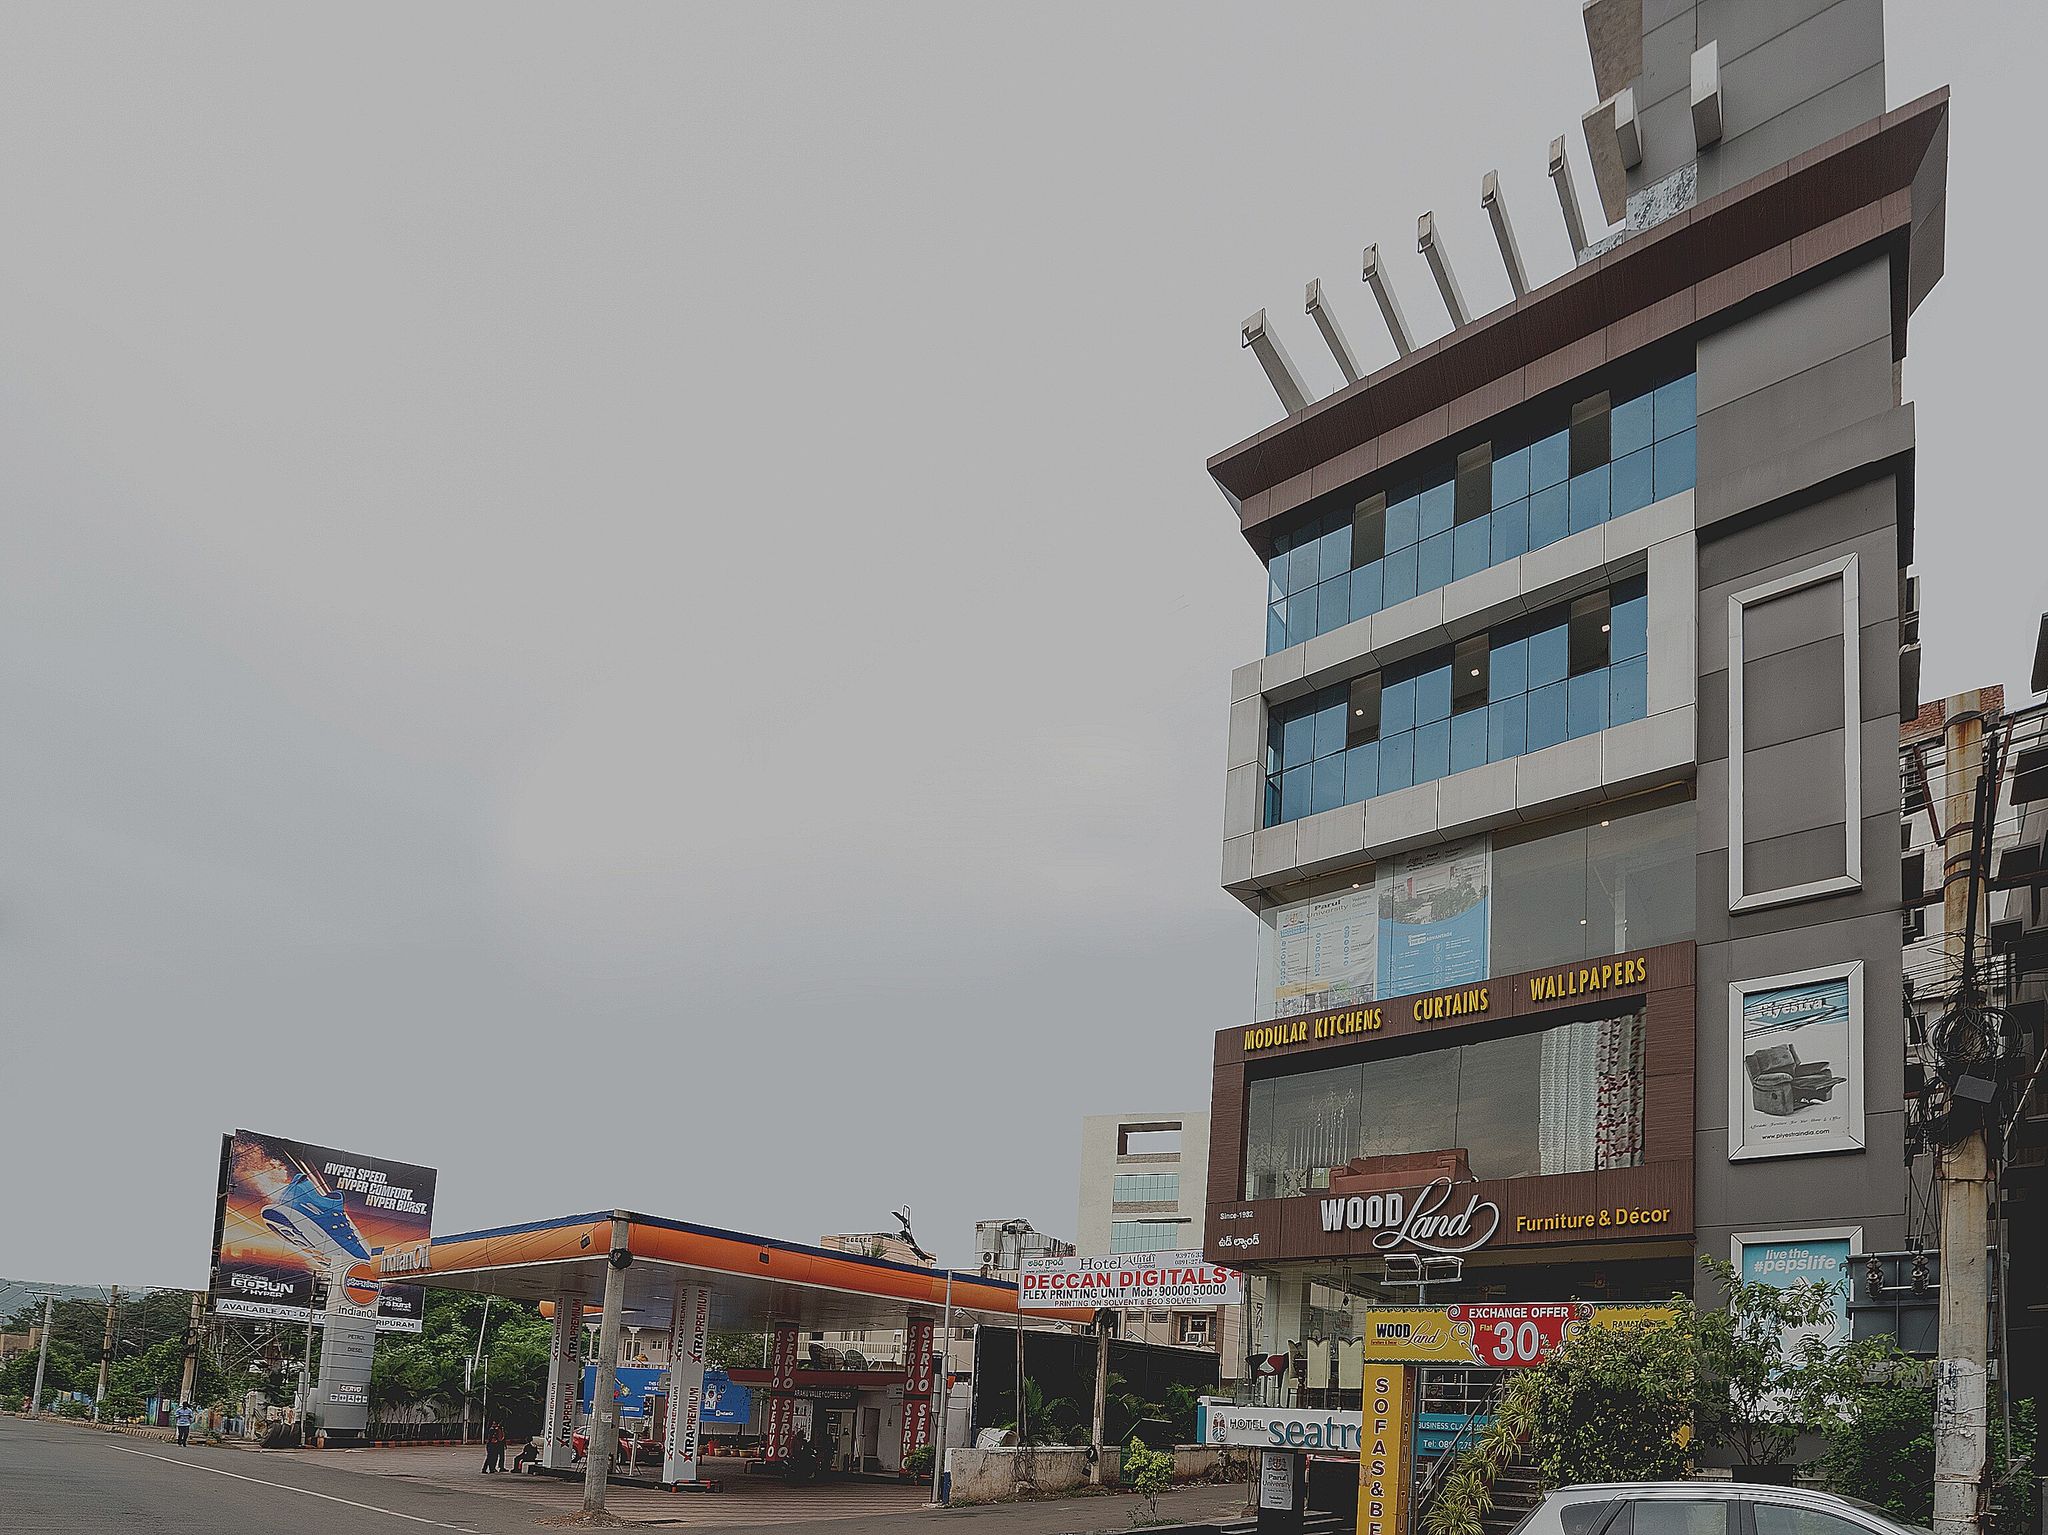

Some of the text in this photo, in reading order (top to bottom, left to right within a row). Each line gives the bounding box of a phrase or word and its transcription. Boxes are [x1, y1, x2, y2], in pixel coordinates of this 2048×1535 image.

[1314, 899, 1341, 911] Parul
[1530, 957, 1646, 1001] WALLPAPERS
[1413, 988, 1489, 1022] CURTAINS
[1244, 1008, 1382, 1051] MODULAR KITCHENS
[324, 1162, 388, 1184] HYPER SPEED.
[336, 1177, 369, 1193] HYPER
[365, 1194, 396, 1210] HYPER
[1320, 1176, 1500, 1254] WOOD Land
[1516, 1206, 1671, 1232] Furniture & Décor
[380, 1244, 432, 1273] IndianOil
[1079, 1256, 1122, 1271] Hotel
[1753, 1255, 1837, 1275] #pepslife
[1765, 1248, 1810, 1260] live the
[1023, 1267, 1228, 1290] DECCAN DIGITALS
[250, 1290, 284, 1298] HYPER
[1022, 1289, 1047, 1300] FLEX
[1050, 1288, 1098, 1300] PRINTING
[1101, 1287, 1126, 1298] UNIT
[1193, 1284, 1226, 1296] 50000
[1054, 1300, 1089, 1308] PRINTING
[1091, 1299, 1102, 1307] ON
[1104, 1298, 1139, 1306] SOLVENT
[1146, 1298, 1166, 1306] ECO
[1166, 1297, 1203, 1305] SOLVENT
[222, 1302, 278, 1315] AVAILABLE
[338, 1305, 377, 1319] IndianOil
[1469, 1306, 1569, 1319] EXCHANGE OFFER
[563, 1298, 582, 1364] XTRAPREMIUM
[687, 1289, 708, 1365] XTRAPREMIUM
[1376, 1319, 1449, 1352] WOOD Land
[1479, 1324, 1493, 1332] Flat
[772, 1330, 782, 1389] SERVO
[782, 1330, 795, 1389] SERVO
[906, 1325, 917, 1392] SERVO
[918, 1325, 931, 1392] SERVO
[556, 1382, 575, 1449] XTRAPREMIUM
[679, 1387, 700, 1464] XTRAPREMIUM
[1229, 1418, 1267, 1431] HOTEL
[1370, 1376, 1391, 1477] SOFAS
[1418, 1421, 1449, 1430] BUSINESS
[767, 1398, 778, 1458] SERVO
[777, 1399, 791, 1458] SERVO
[1423, 1439, 1437, 1447] Tel:
[1262, 1480, 1292, 1489] University
[1268, 1473, 1288, 1481] Parul
[1370, 1480, 1385, 1498] &
